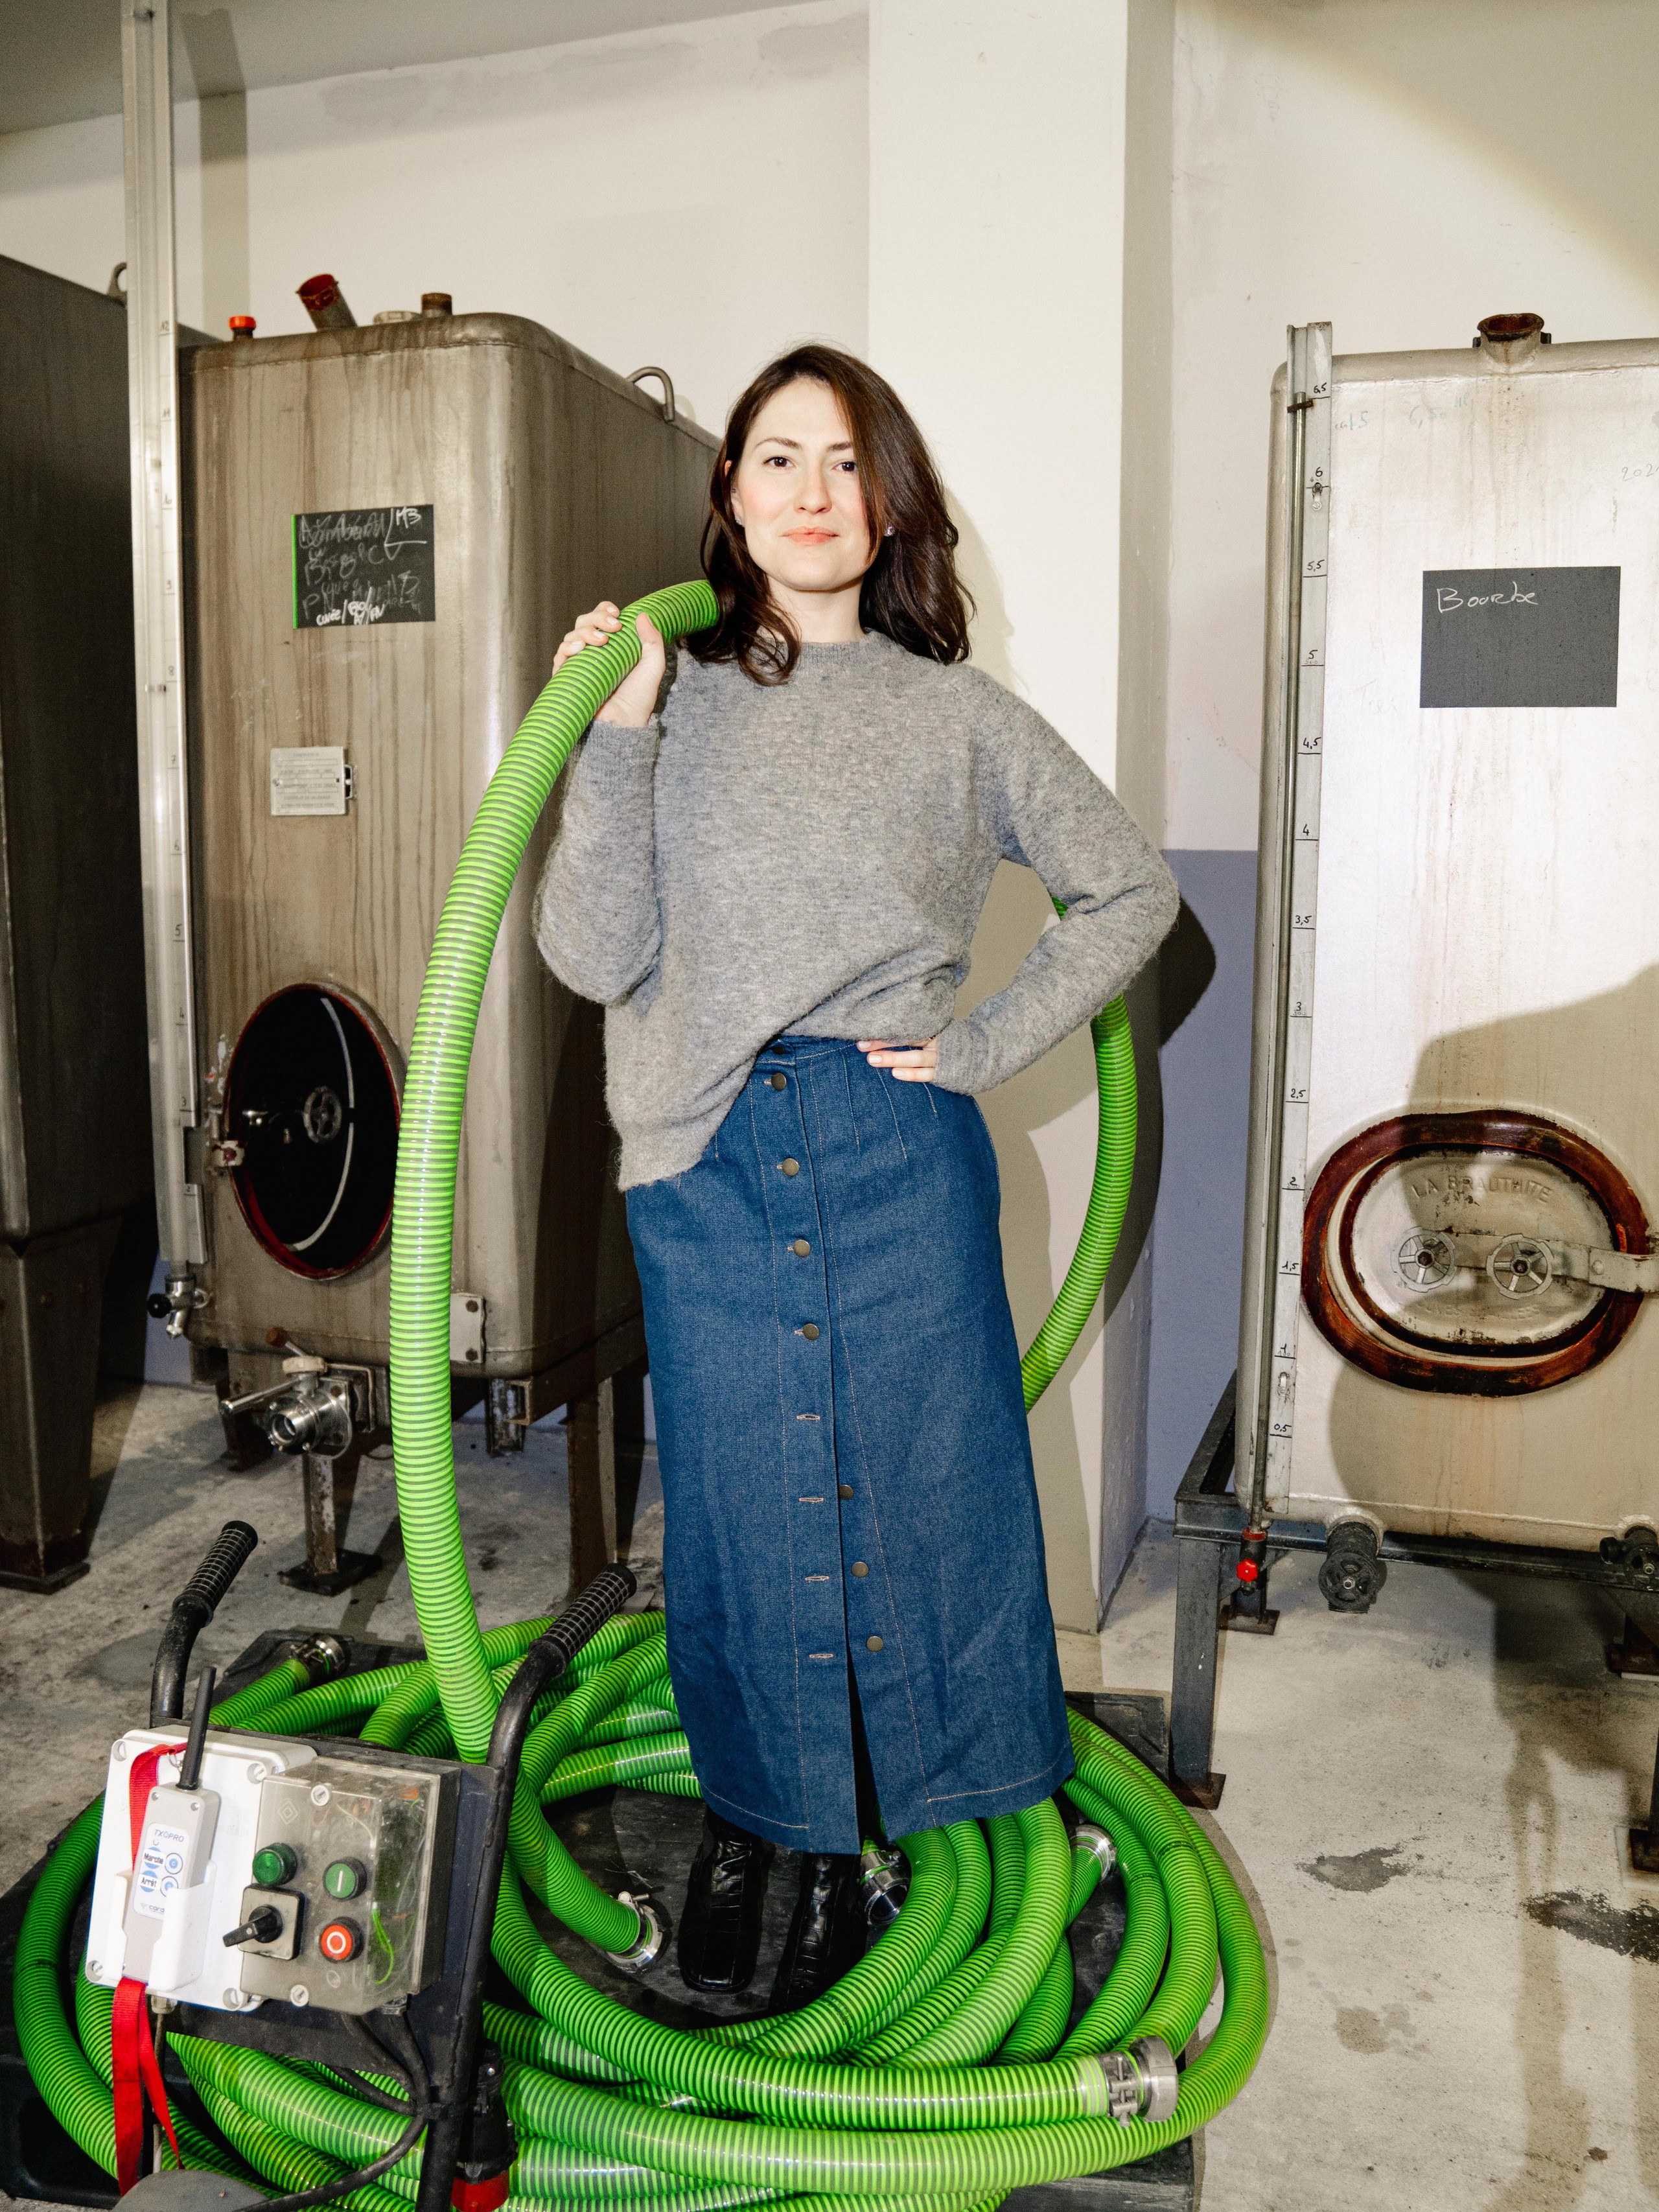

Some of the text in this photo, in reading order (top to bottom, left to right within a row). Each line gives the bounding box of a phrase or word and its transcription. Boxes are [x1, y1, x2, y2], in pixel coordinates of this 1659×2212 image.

[1315, 466, 1323, 477] 6
[1306, 559, 1325, 572] 5,5
[1308, 649, 1318, 659] 5
[1303, 737, 1321, 749] 4,5
[1303, 824, 1310, 836] 4
[1295, 915, 1312, 926] 3,5
[175, 924, 183, 937] 5
[1296, 1001, 1302, 1011] 3
[179, 1007, 185, 1019] 4
[1290, 1088, 1306, 1099] 2,5
[181, 1096, 187, 1107] 3
[1290, 1176, 1297, 1186] 2
[1282, 1261, 1299, 1272] 1,5
[1273, 1423, 1292, 1432] 0,5
[143, 1852, 164, 1865] Marche
